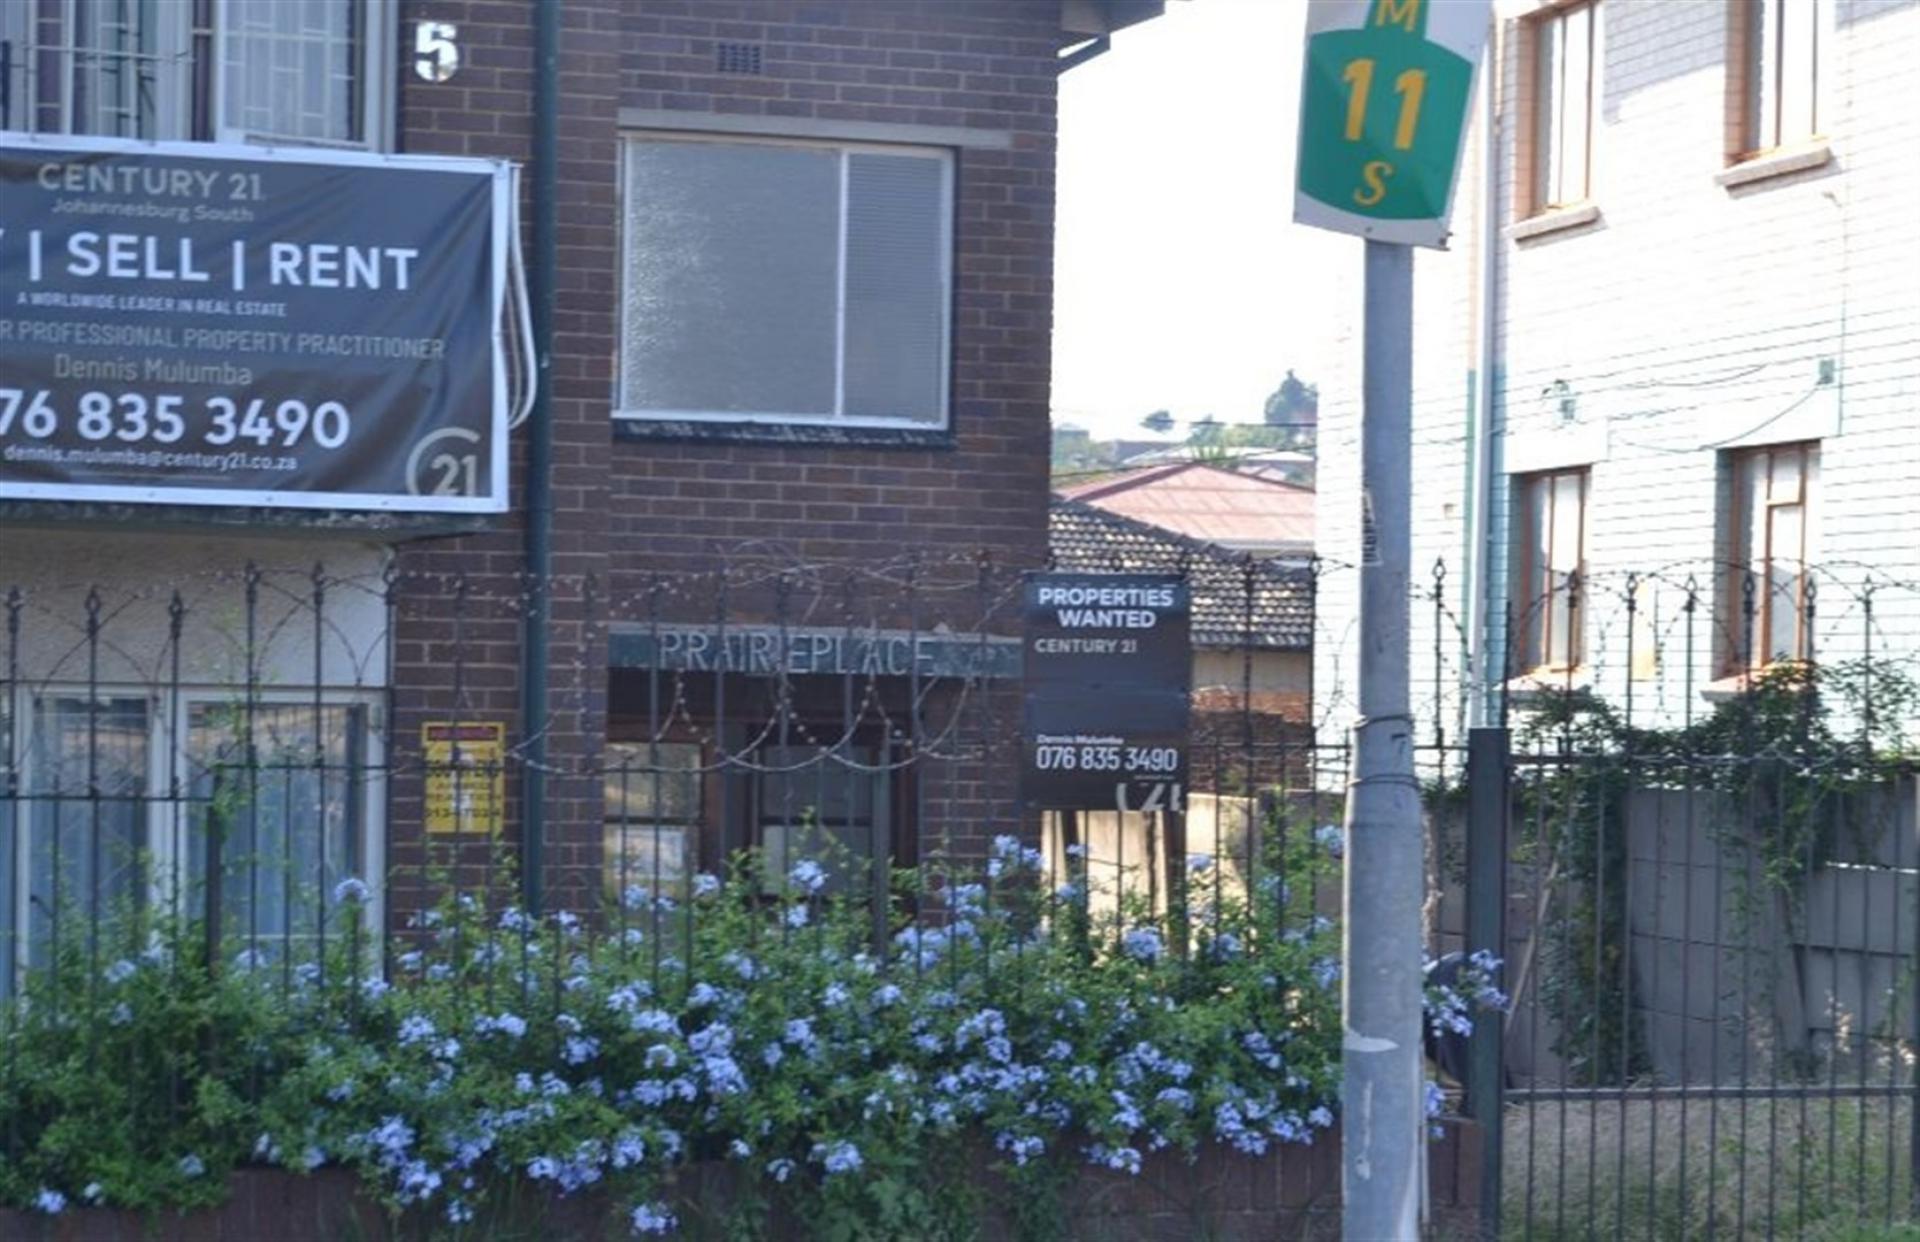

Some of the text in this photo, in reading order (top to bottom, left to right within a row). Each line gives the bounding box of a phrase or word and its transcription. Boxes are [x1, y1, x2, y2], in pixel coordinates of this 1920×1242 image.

[415, 21, 459, 82] 5
[1342, 58, 1426, 150] 11
[38, 163, 263, 200] CENTURY 21
[1354, 160, 1394, 206] S
[52, 199, 254, 223] Johannesburg South
[67, 231, 210, 282] SELL
[269, 243, 418, 290] RENT
[119, 295, 174, 312] LEADER
[198, 300, 231, 315] REAL
[235, 302, 287, 317] ESTATE
[18, 321, 177, 348] PROFESSIONAL
[184, 329, 289, 352] PROPERTY
[298, 334, 444, 359] PRACTITIONER
[54, 353, 253, 386] Dennis Mulumba
[77, 392, 185, 443] 835
[205, 397, 349, 449] 3490
[1038, 588, 1174, 607] PROPERTIES
[1058, 610, 1156, 628] WANTED
[1035, 638, 1138, 653] CENTURY 21
[1036, 746, 1178, 771] 076 835 3490
